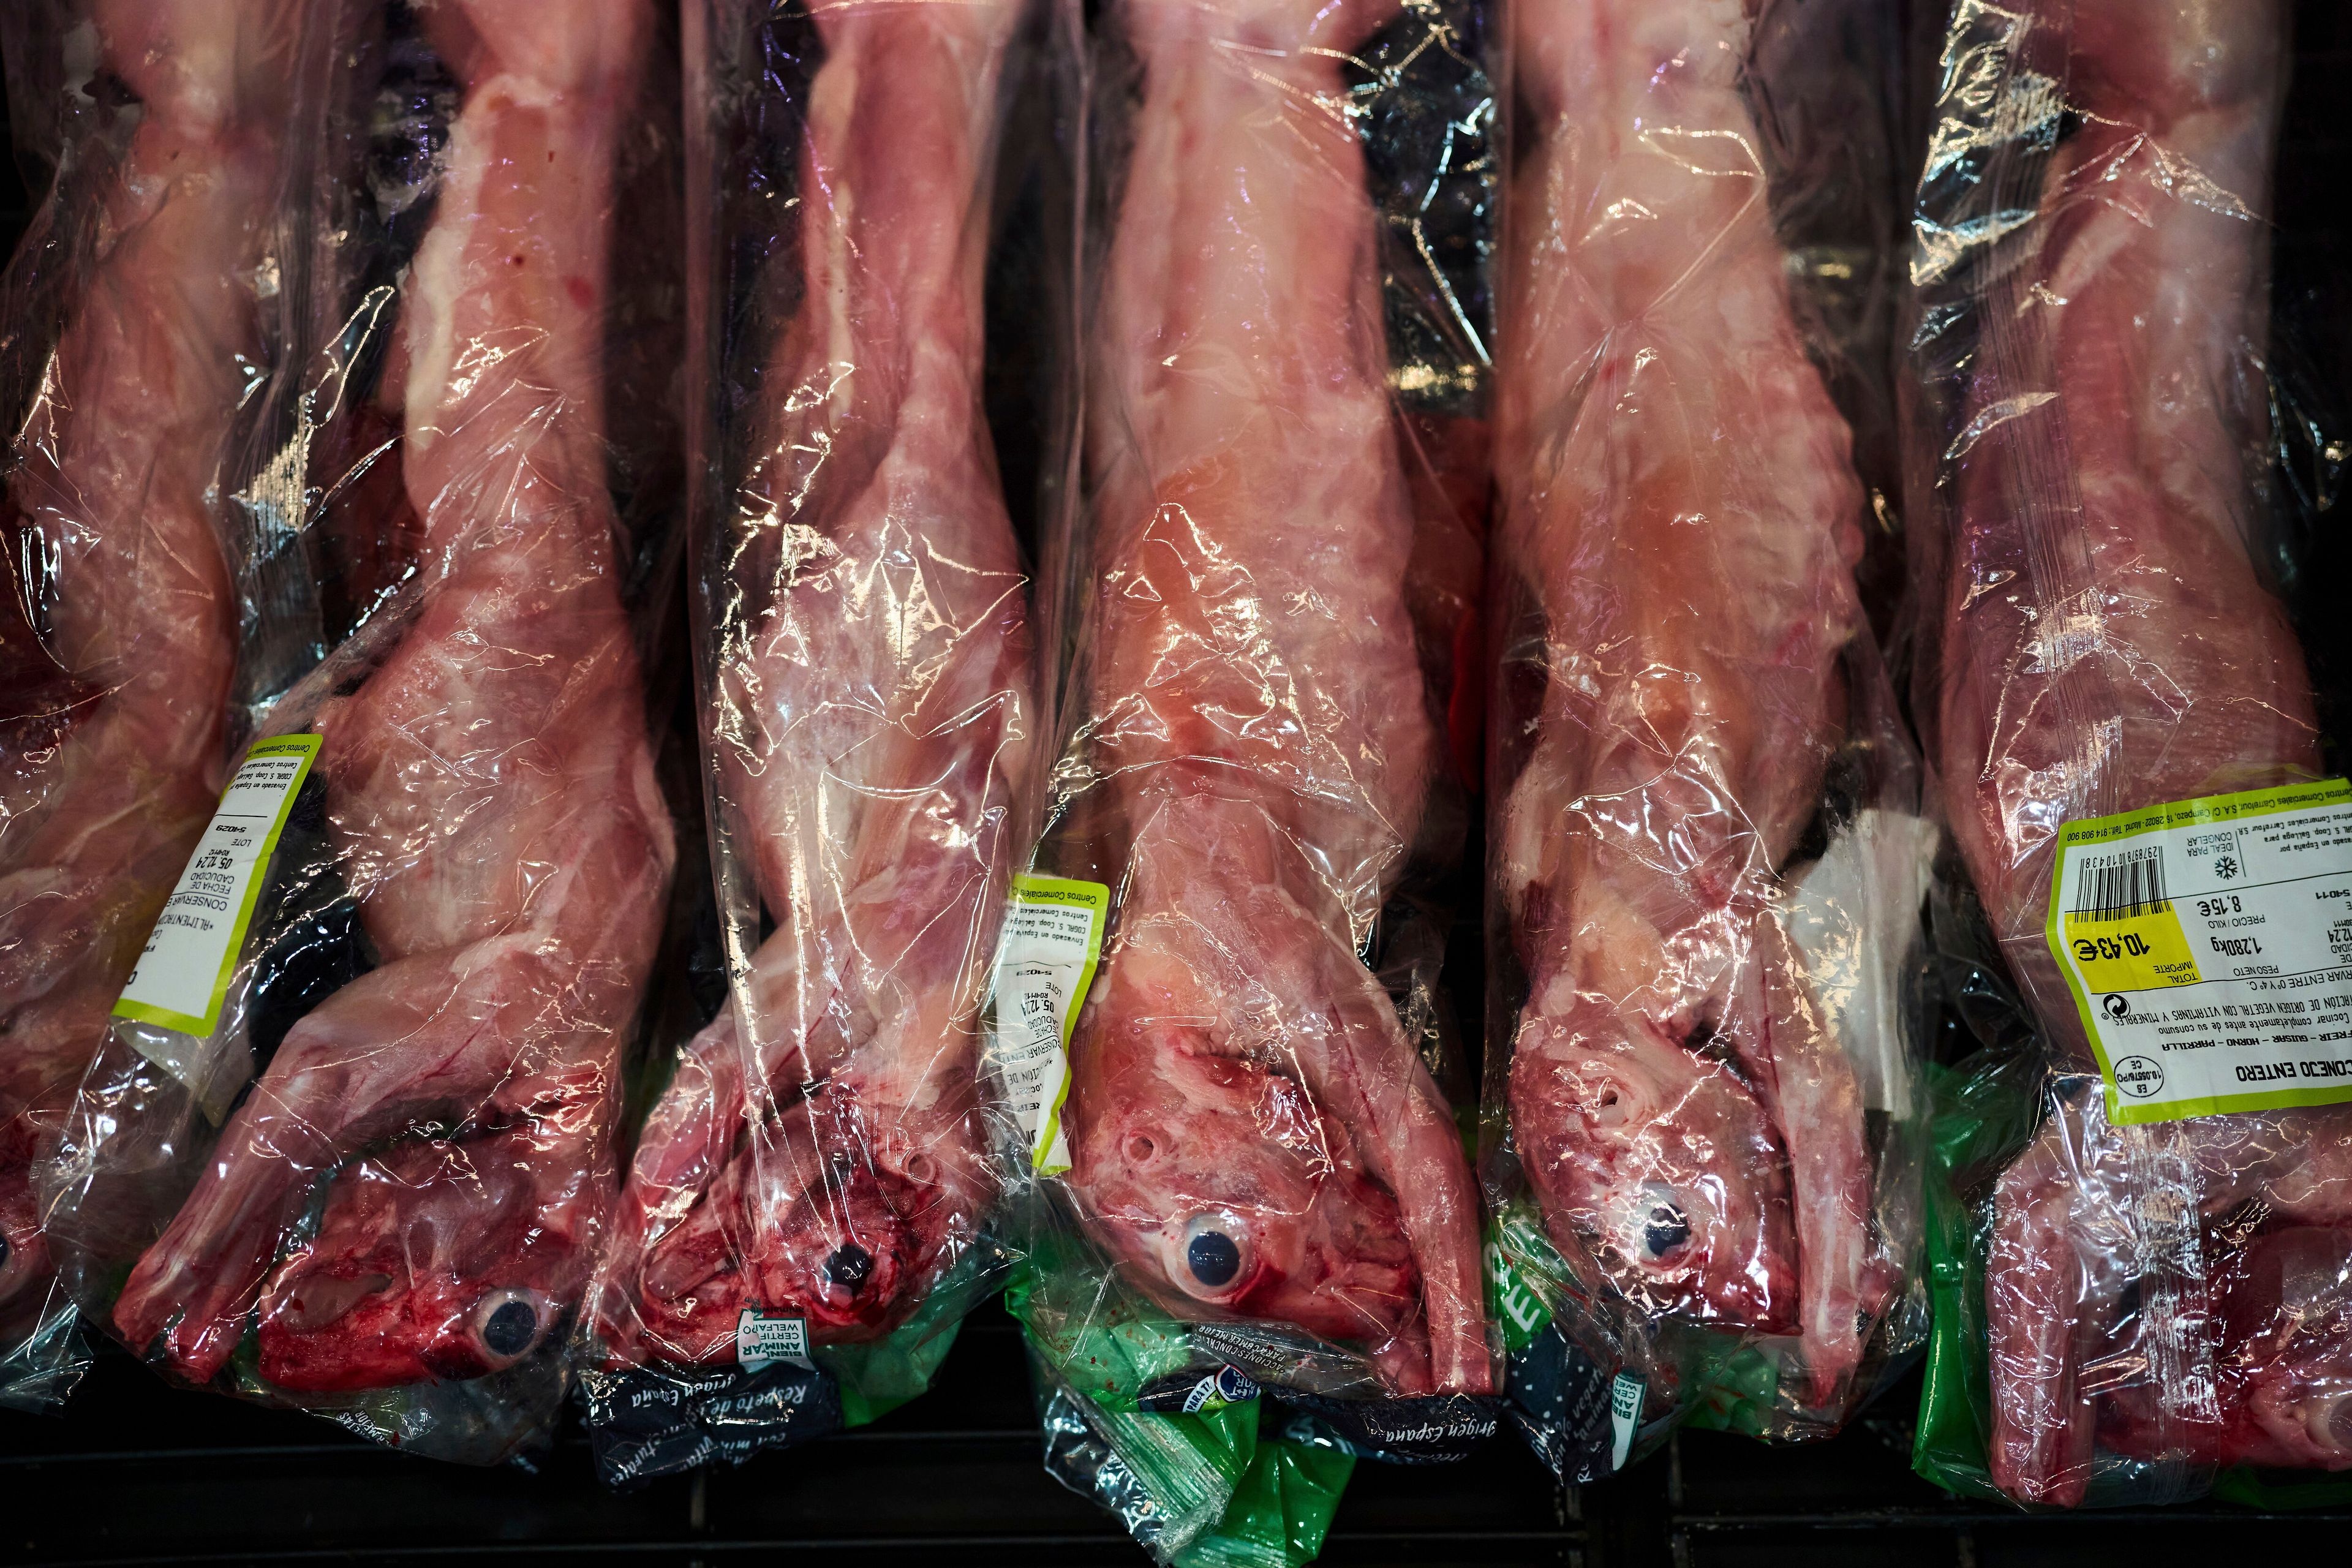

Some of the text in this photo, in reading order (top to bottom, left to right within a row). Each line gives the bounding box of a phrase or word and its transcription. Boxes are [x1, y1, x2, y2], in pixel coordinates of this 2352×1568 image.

[2277, 792, 2323, 805] Comerciales
[2212, 807, 2220, 816] C/
[2222, 805, 2236, 813] S.A.
[2145, 816, 2163, 826] 28022
[2288, 816, 2330, 827] Comerciales
[2096, 828, 2107, 837] 914
[2252, 823, 2284, 832] Carrefour
[2313, 826, 2331, 835] Coop.
[2067, 832, 2079, 841] 900
[2187, 832, 2232, 846] CONGELAR
[2264, 834, 2279, 842] para
[2187, 842, 2233, 857] IDEAL PARA
[2280, 843, 2290, 852] por
[2294, 840, 2318, 852] España
[190, 872, 235, 884] CADUCIDAD
[203, 882, 231, 894] FECHA
[2315, 889, 2350, 899] 54011
[1021, 889, 1065, 900] Comerciales
[1067, 892, 1096, 904] Centros
[174, 895, 227, 911] CONSERVAR
[2197, 895, 2241, 916] 8,15€
[1062, 911, 1088, 922] Centros
[2232, 914, 2265, 927] PRECIO
[1038, 919, 1055, 929] Coop.
[1067, 924, 1085, 934] COGAL
[2208, 920, 2226, 929] KILO
[1052, 933, 1083, 946] Envasado
[2073, 933, 2150, 961] 10,43€
[2211, 937, 2262, 956] 1,280kg
[2153, 961, 2193, 974] IMPORTE
[2233, 965, 2279, 976] PESO NETO
[2168, 973, 2198, 984] TOTAL
[2288, 973, 2323, 988] ENTRE
[1046, 982, 1061, 998] LOTE
[2246, 981, 2257, 990] C.
[2269, 981, 2276, 989] Y
[2222, 1005, 2237, 1016] CON
[2239, 1003, 2275, 1016] VEGETAL
[2276, 1001, 2305, 1012] ORIGEN
[2309, 999, 2320, 1011] DE
[2162, 1012, 2169, 1022] Y
[2171, 1006, 2220, 1020] VITAMINAS
[2317, 1012, 2349, 1025] Cocinar
[1027, 1016, 1058, 1029] CADUCIDAD
[2113, 1013, 2159, 1026] MINERALES
[2249, 1017, 2311, 1031] completamente
[2158, 1025, 2194, 1035] consumo
[2211, 1022, 2221, 1033] de
[2225, 1021, 2245, 1032] antes
[2162, 1040, 2215, 1050] PARRILLA
[2226, 1038, 2260, 1046] HORNO
[2236, 1062, 2297, 1082] ENTERO
[1007, 1073, 1019, 1085] DE
[1198, 1325, 1286, 1362] PARA COMER MEJOR
[631, 1388, 679, 1408] España
[711, 1384, 807, 1415] Respeto de
[355, 1409, 379, 1437] MEJOR
[1385, 1422, 1443, 1444] España
